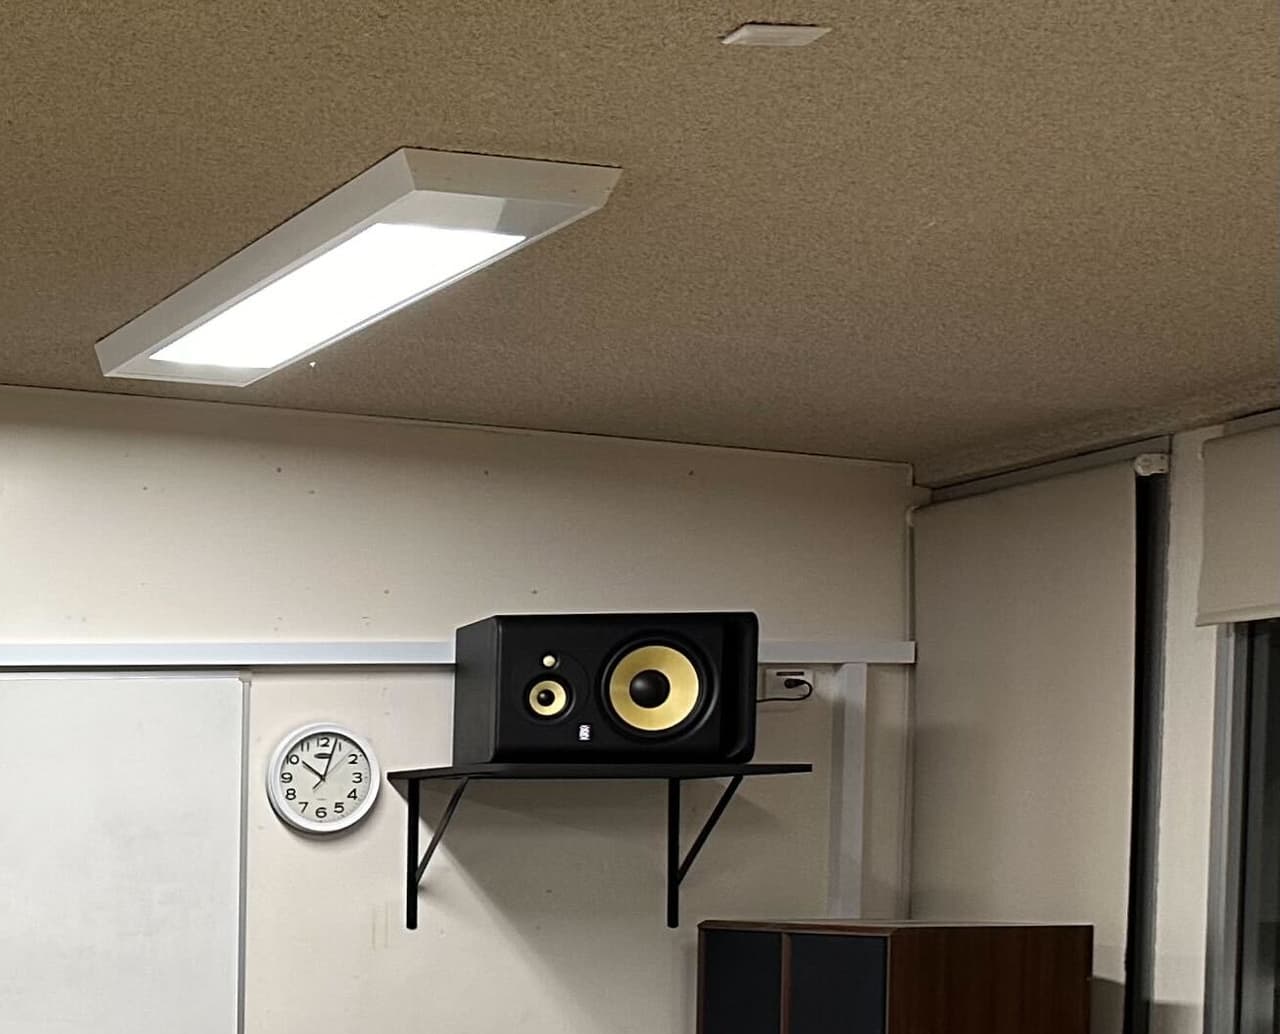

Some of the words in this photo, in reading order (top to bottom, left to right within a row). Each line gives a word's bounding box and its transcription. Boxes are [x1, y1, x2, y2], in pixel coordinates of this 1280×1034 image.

[347, 753, 359, 764] 2
[280, 772, 293, 783] 9
[351, 772, 363, 783] 3
[285, 788, 297, 800] 8
[347, 788, 358, 800] 4
[298, 801, 309, 813] 7
[315, 806, 327, 818] 6
[333, 801, 345, 813] 5
